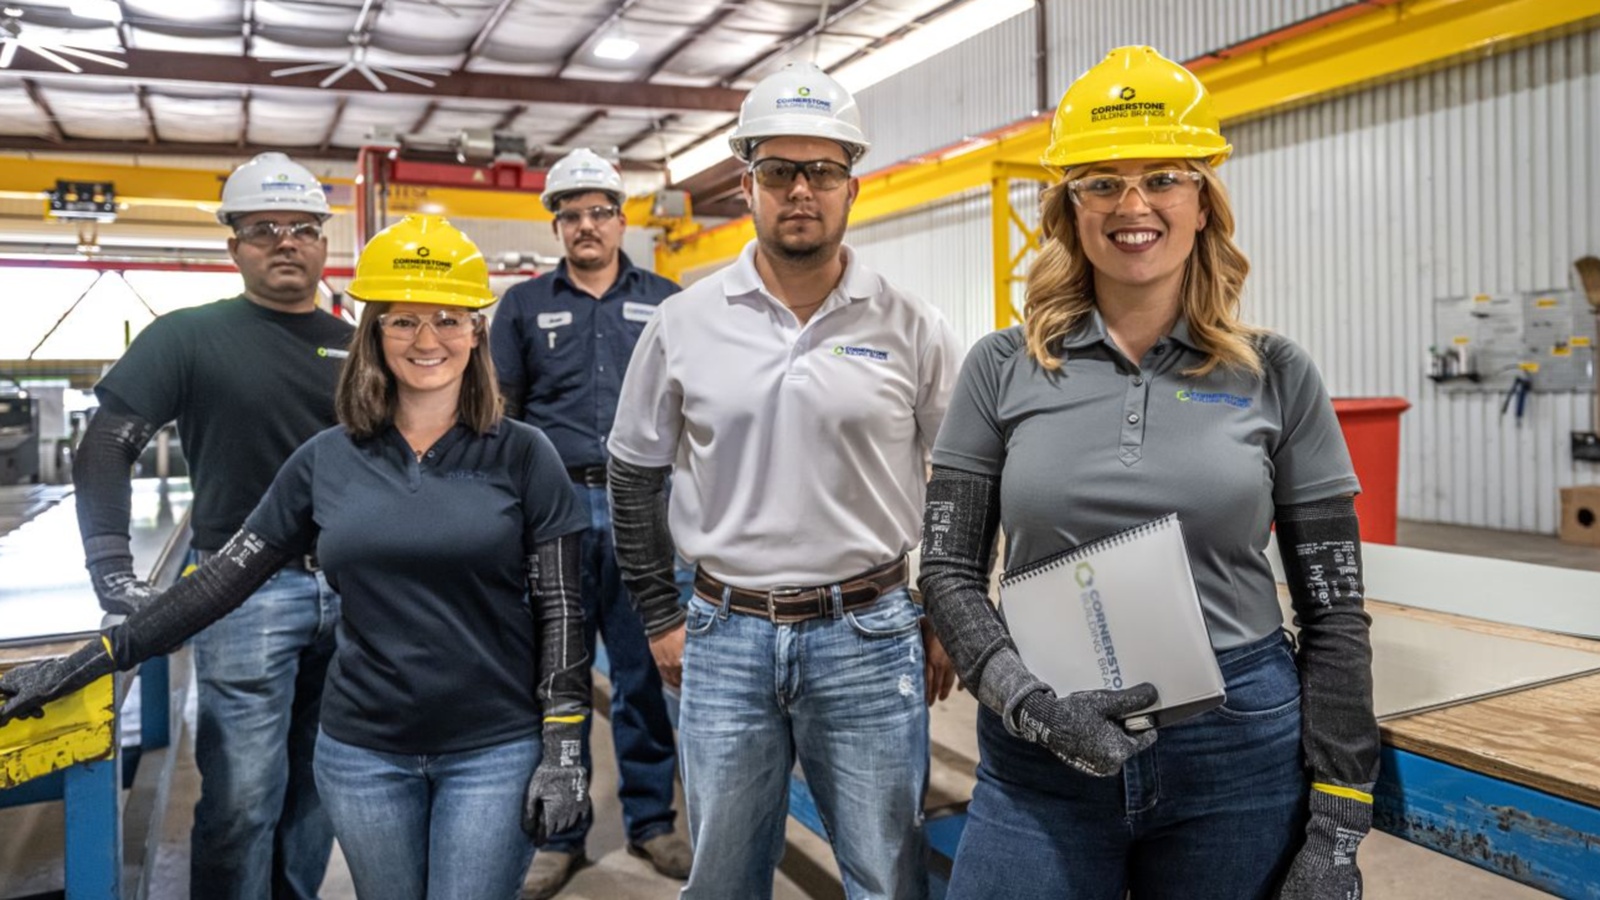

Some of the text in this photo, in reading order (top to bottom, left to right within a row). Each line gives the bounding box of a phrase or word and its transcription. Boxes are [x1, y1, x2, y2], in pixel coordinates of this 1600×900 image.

[1091, 102, 1165, 115] CORNERSTONE
[1091, 109, 1165, 123] BUILDING BRANDS
[393, 258, 452, 268] CORNERSTONE
[1309, 564, 1331, 606] HyFlex
[1080, 592, 1113, 689] BUILDING BRA
[1090, 589, 1123, 689] CORNERSTO
